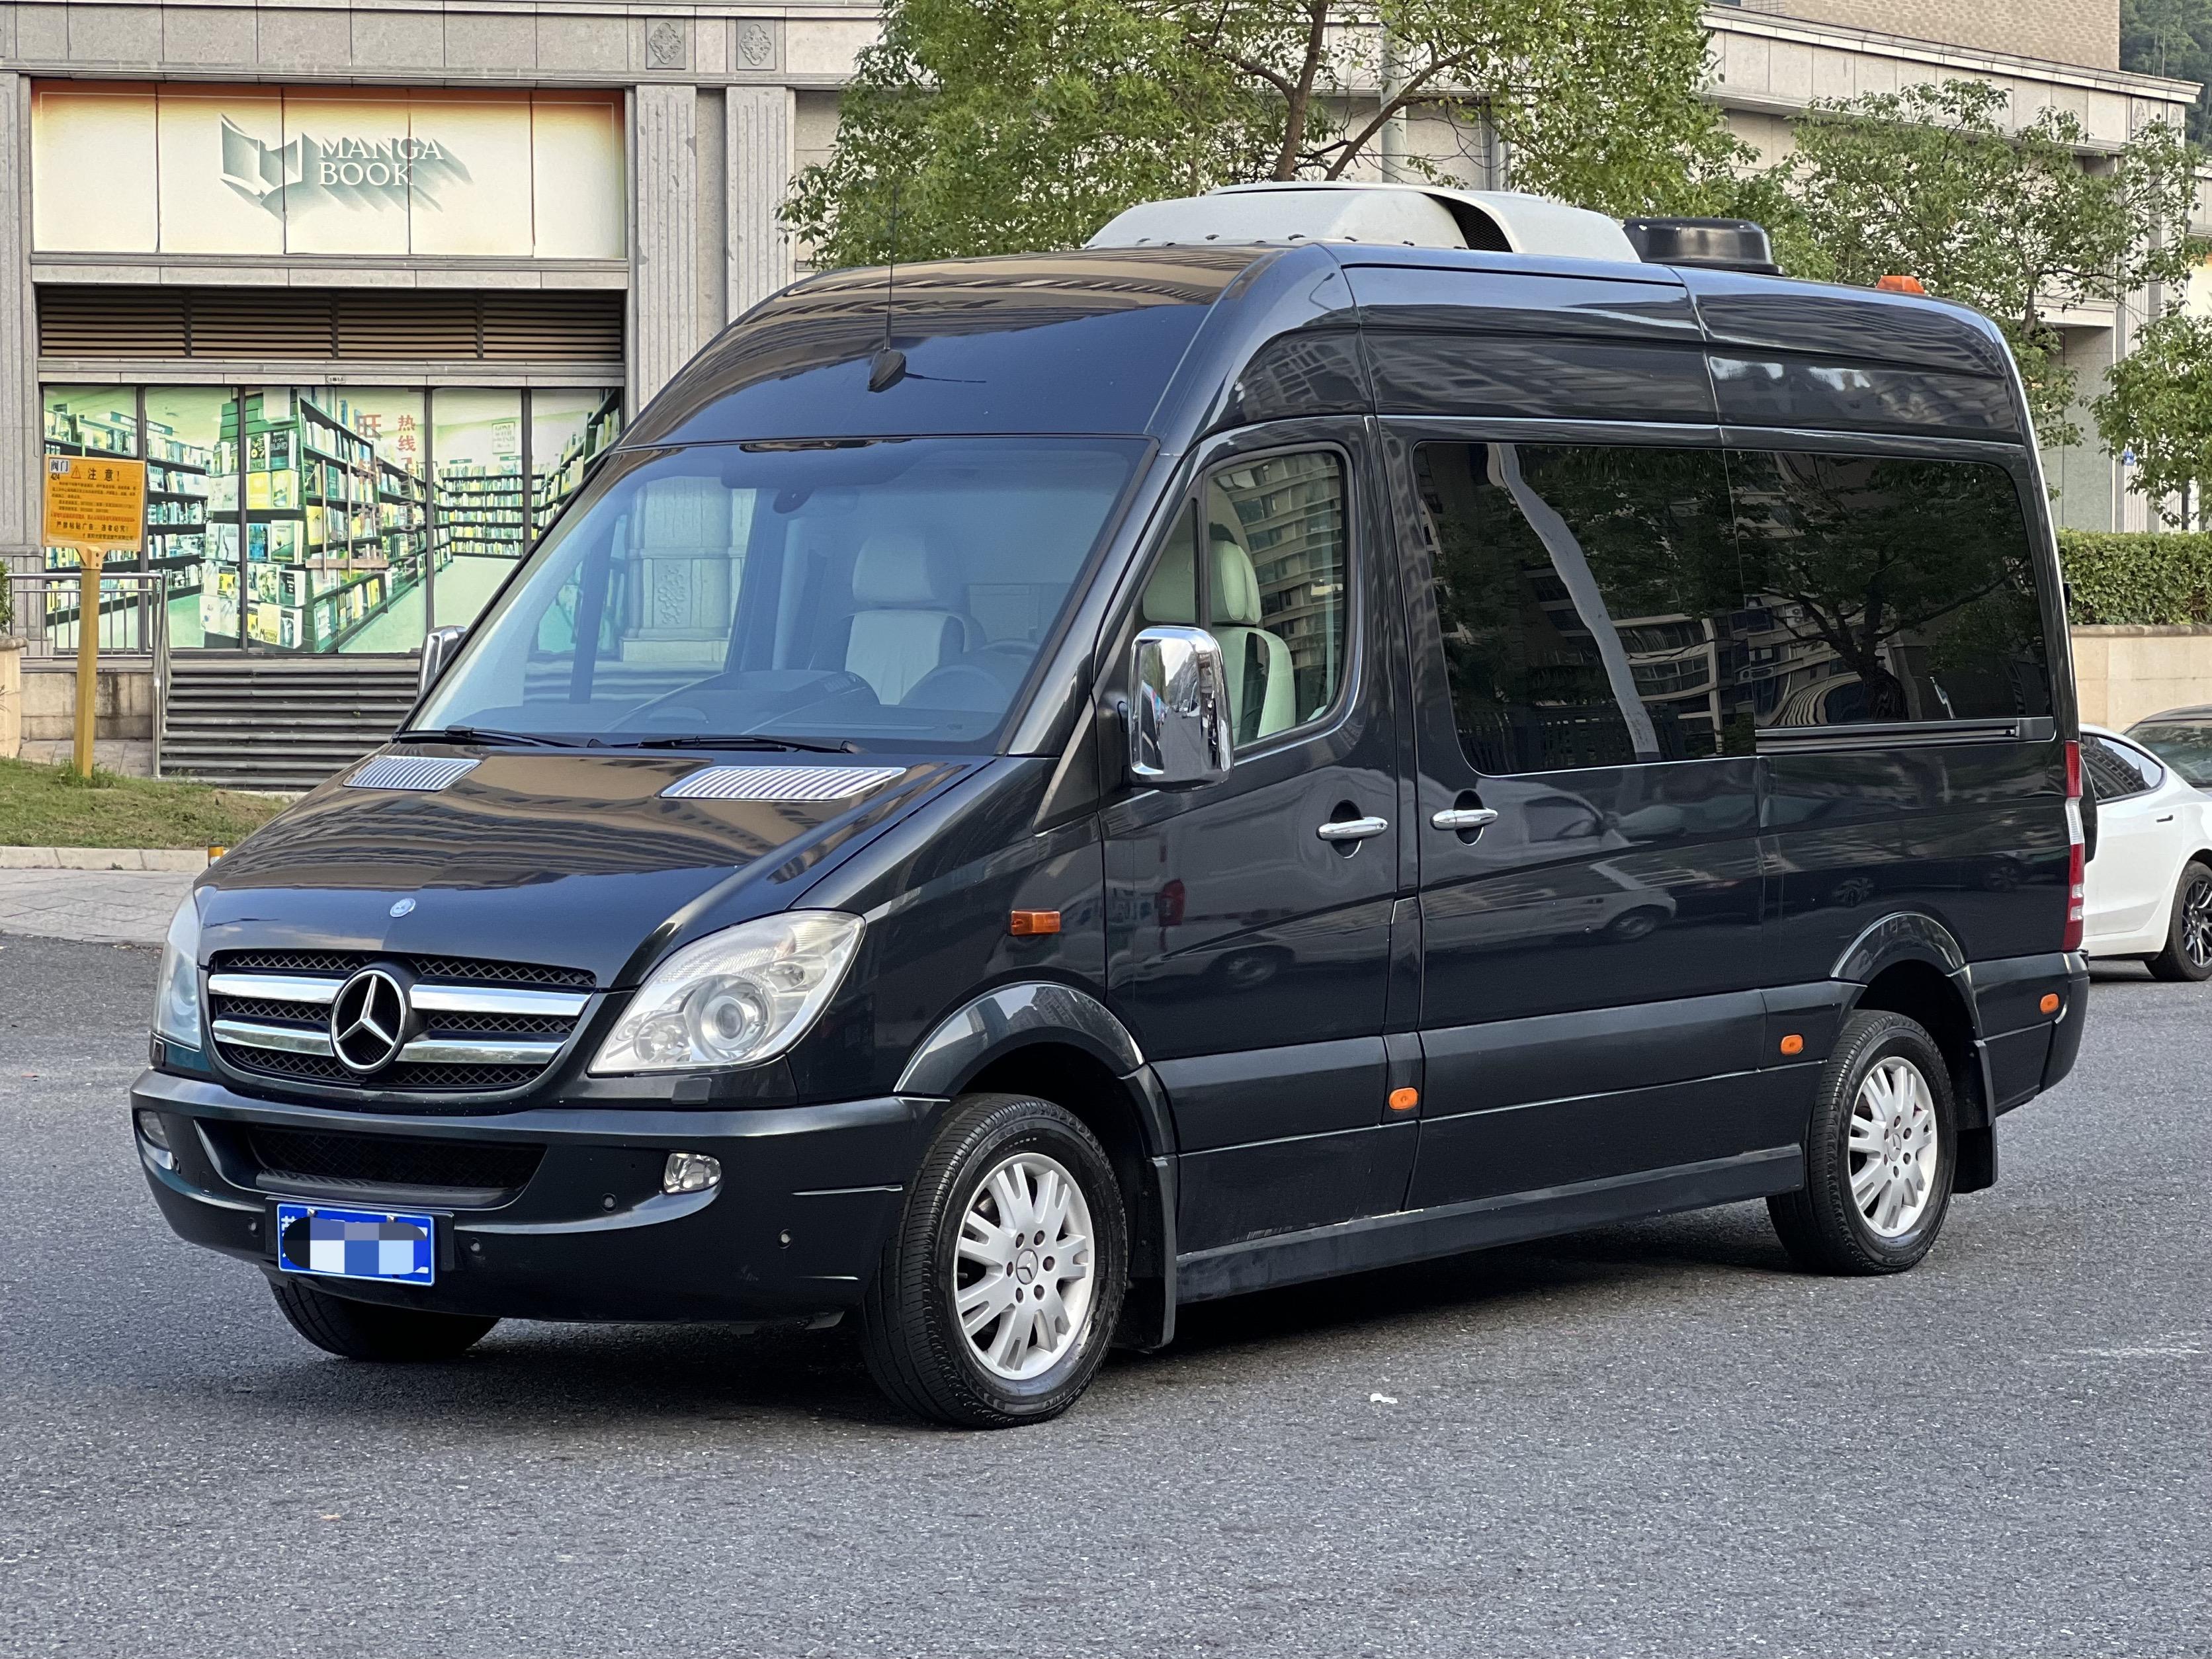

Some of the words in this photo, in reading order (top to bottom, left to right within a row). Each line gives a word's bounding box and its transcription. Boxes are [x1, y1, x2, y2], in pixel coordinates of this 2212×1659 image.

[319, 137, 446, 160] MANGA
[319, 161, 414, 187] BOOK
[51, 460, 69, 472] 阀门
[87, 467, 120, 482] 注意!
